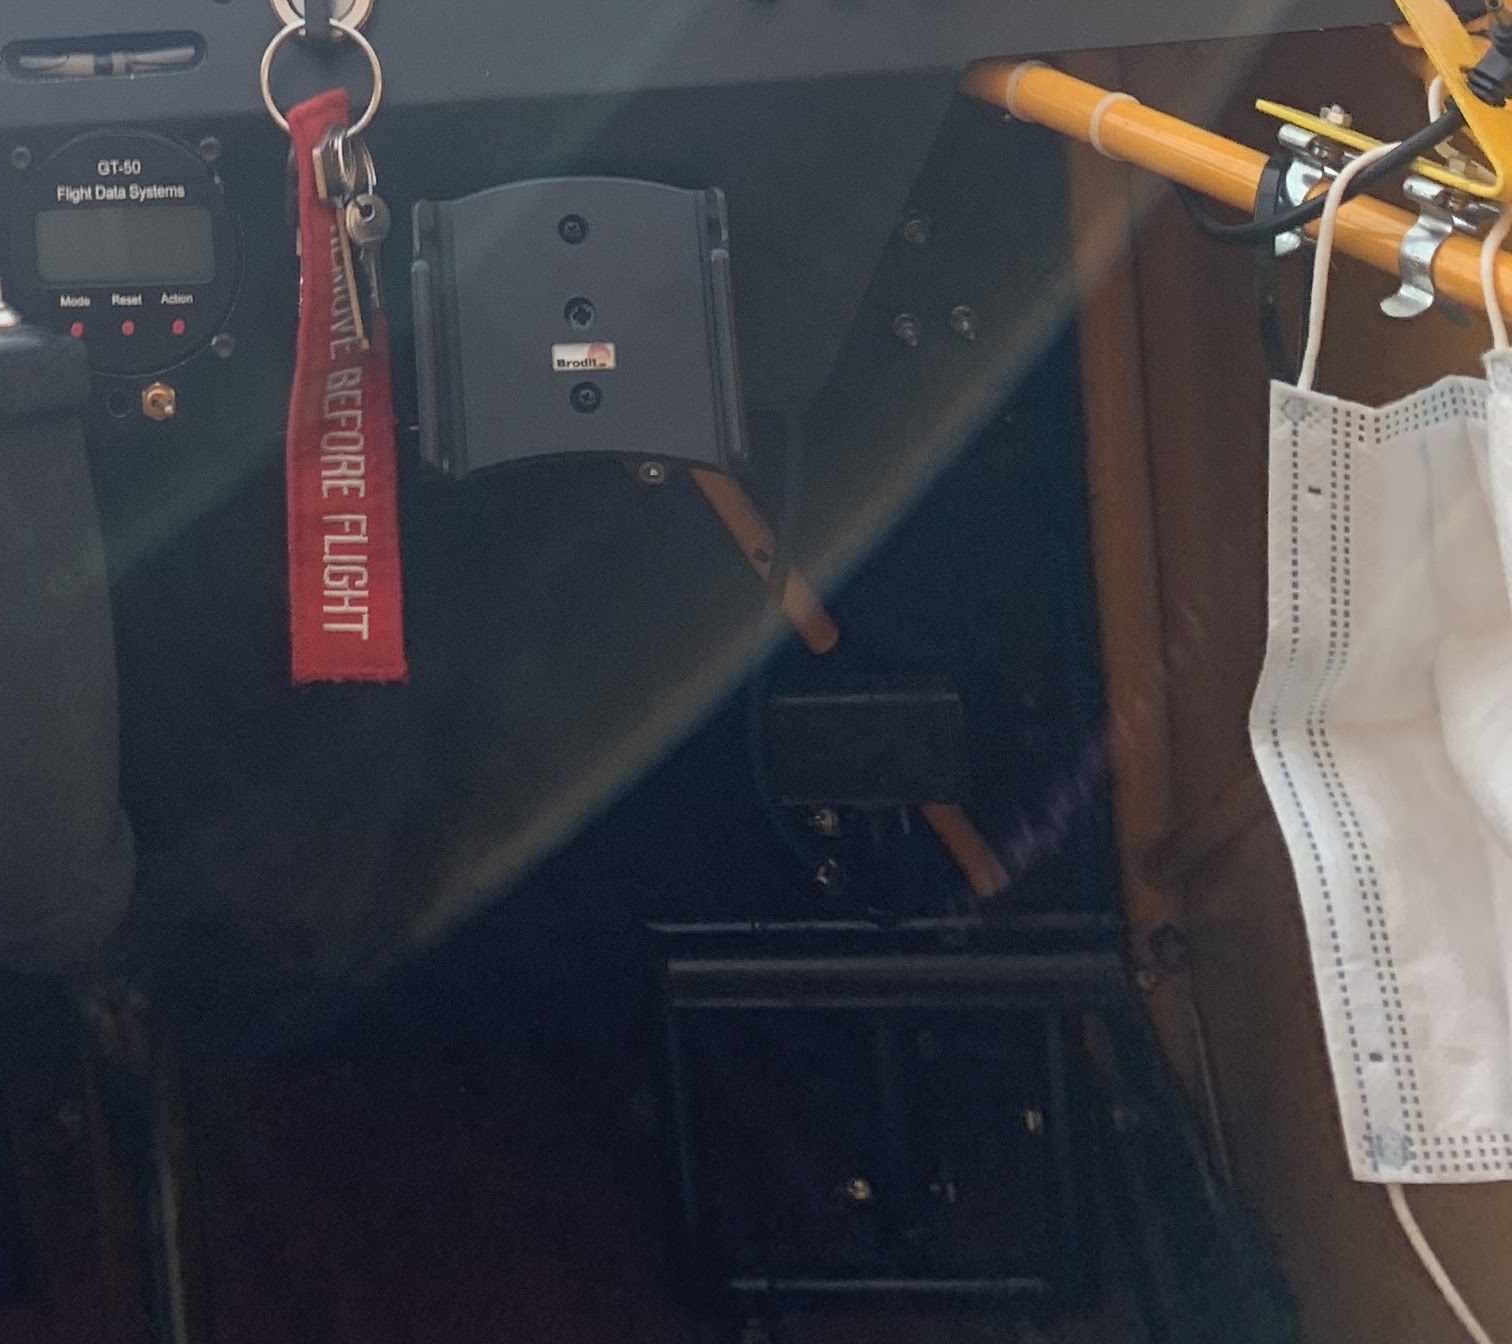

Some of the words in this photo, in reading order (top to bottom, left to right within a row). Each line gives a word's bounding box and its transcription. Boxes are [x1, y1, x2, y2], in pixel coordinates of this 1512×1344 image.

[97, 159, 141, 176] GT-50
[57, 185, 92, 204] Flight
[95, 184, 126, 200] Data
[129, 184, 185, 203] Systems
[60, 294, 90, 307] Mode
[111, 293, 142, 306] Reset
[161, 292, 193, 304] Action
[556, 357, 597, 368] Brodit
[321, 367, 366, 499] BEFORE
[322, 514, 369, 641] FLIGHT
